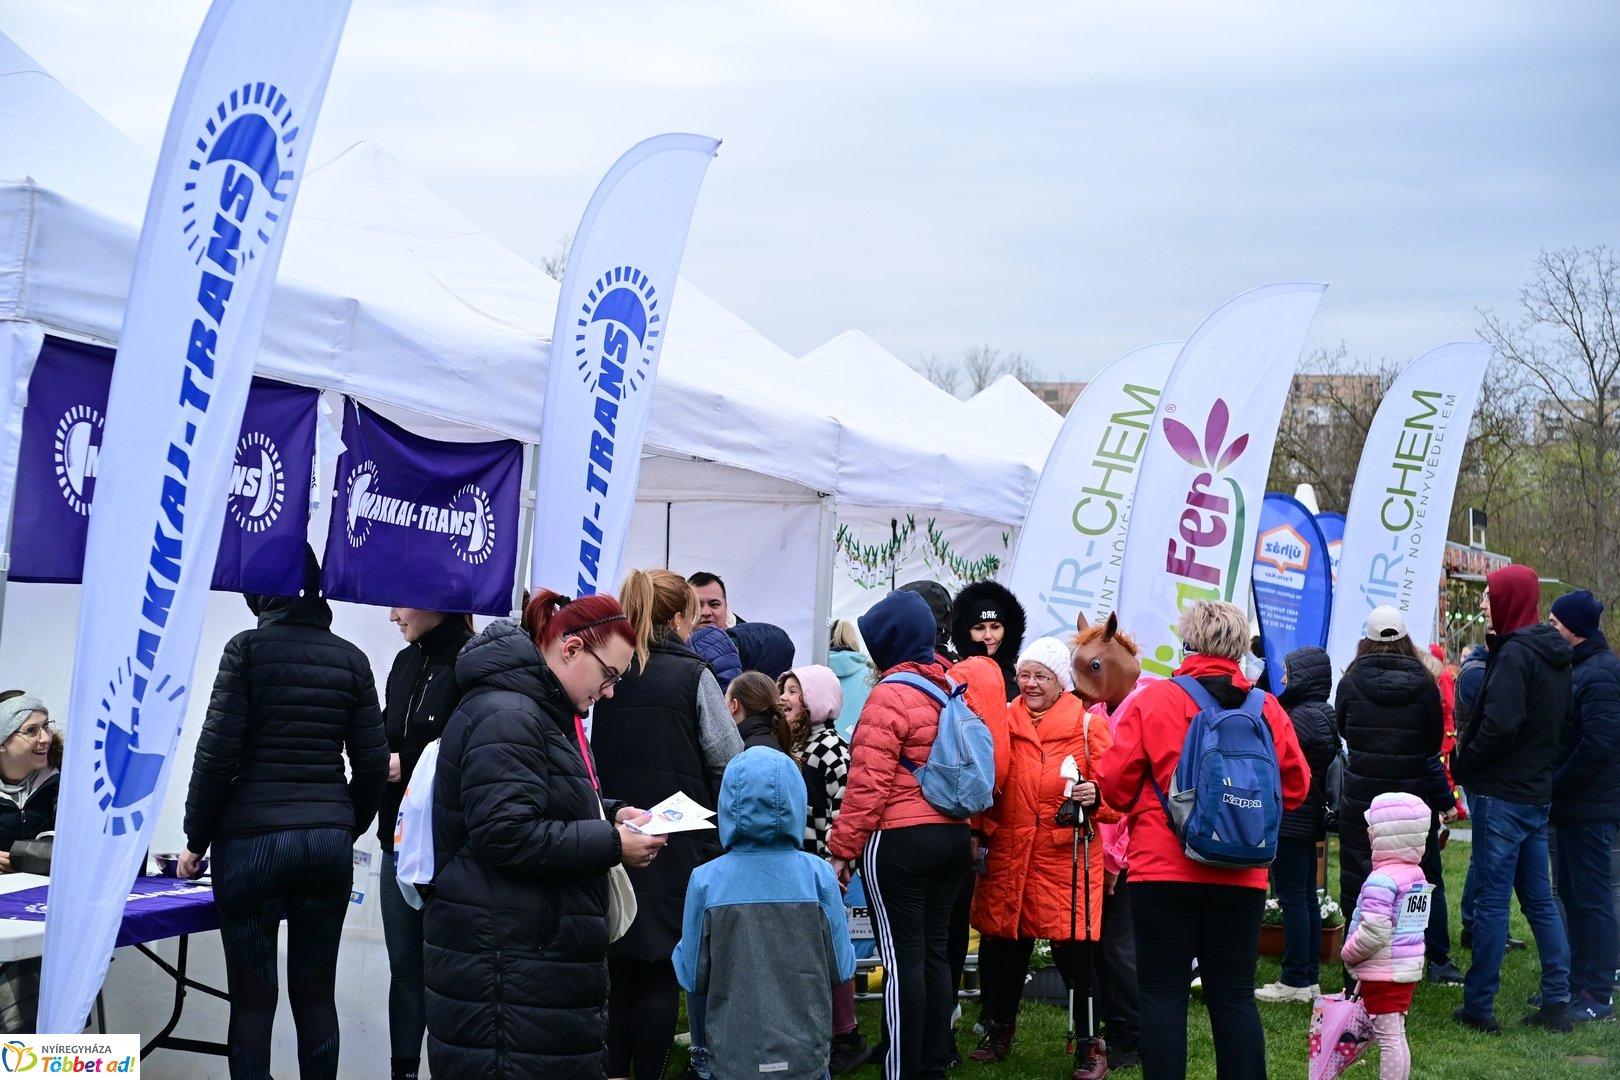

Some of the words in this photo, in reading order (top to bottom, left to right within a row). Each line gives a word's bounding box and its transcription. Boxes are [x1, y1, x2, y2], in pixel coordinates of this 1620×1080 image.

[357, 491, 476, 537] MAKKAI-TRANS
[1038, 383, 1162, 638] YÍR-CHEM
[1360, 390, 1443, 636] ÍR-CHEM
[1399, 566, 1416, 612] MINT
[1409, 394, 1456, 558] NÖVÉNYVÉDELEM
[1095, 575, 1117, 624] MINT
[1222, 793, 1262, 808] Kappa
[1407, 894, 1428, 913] 1646
